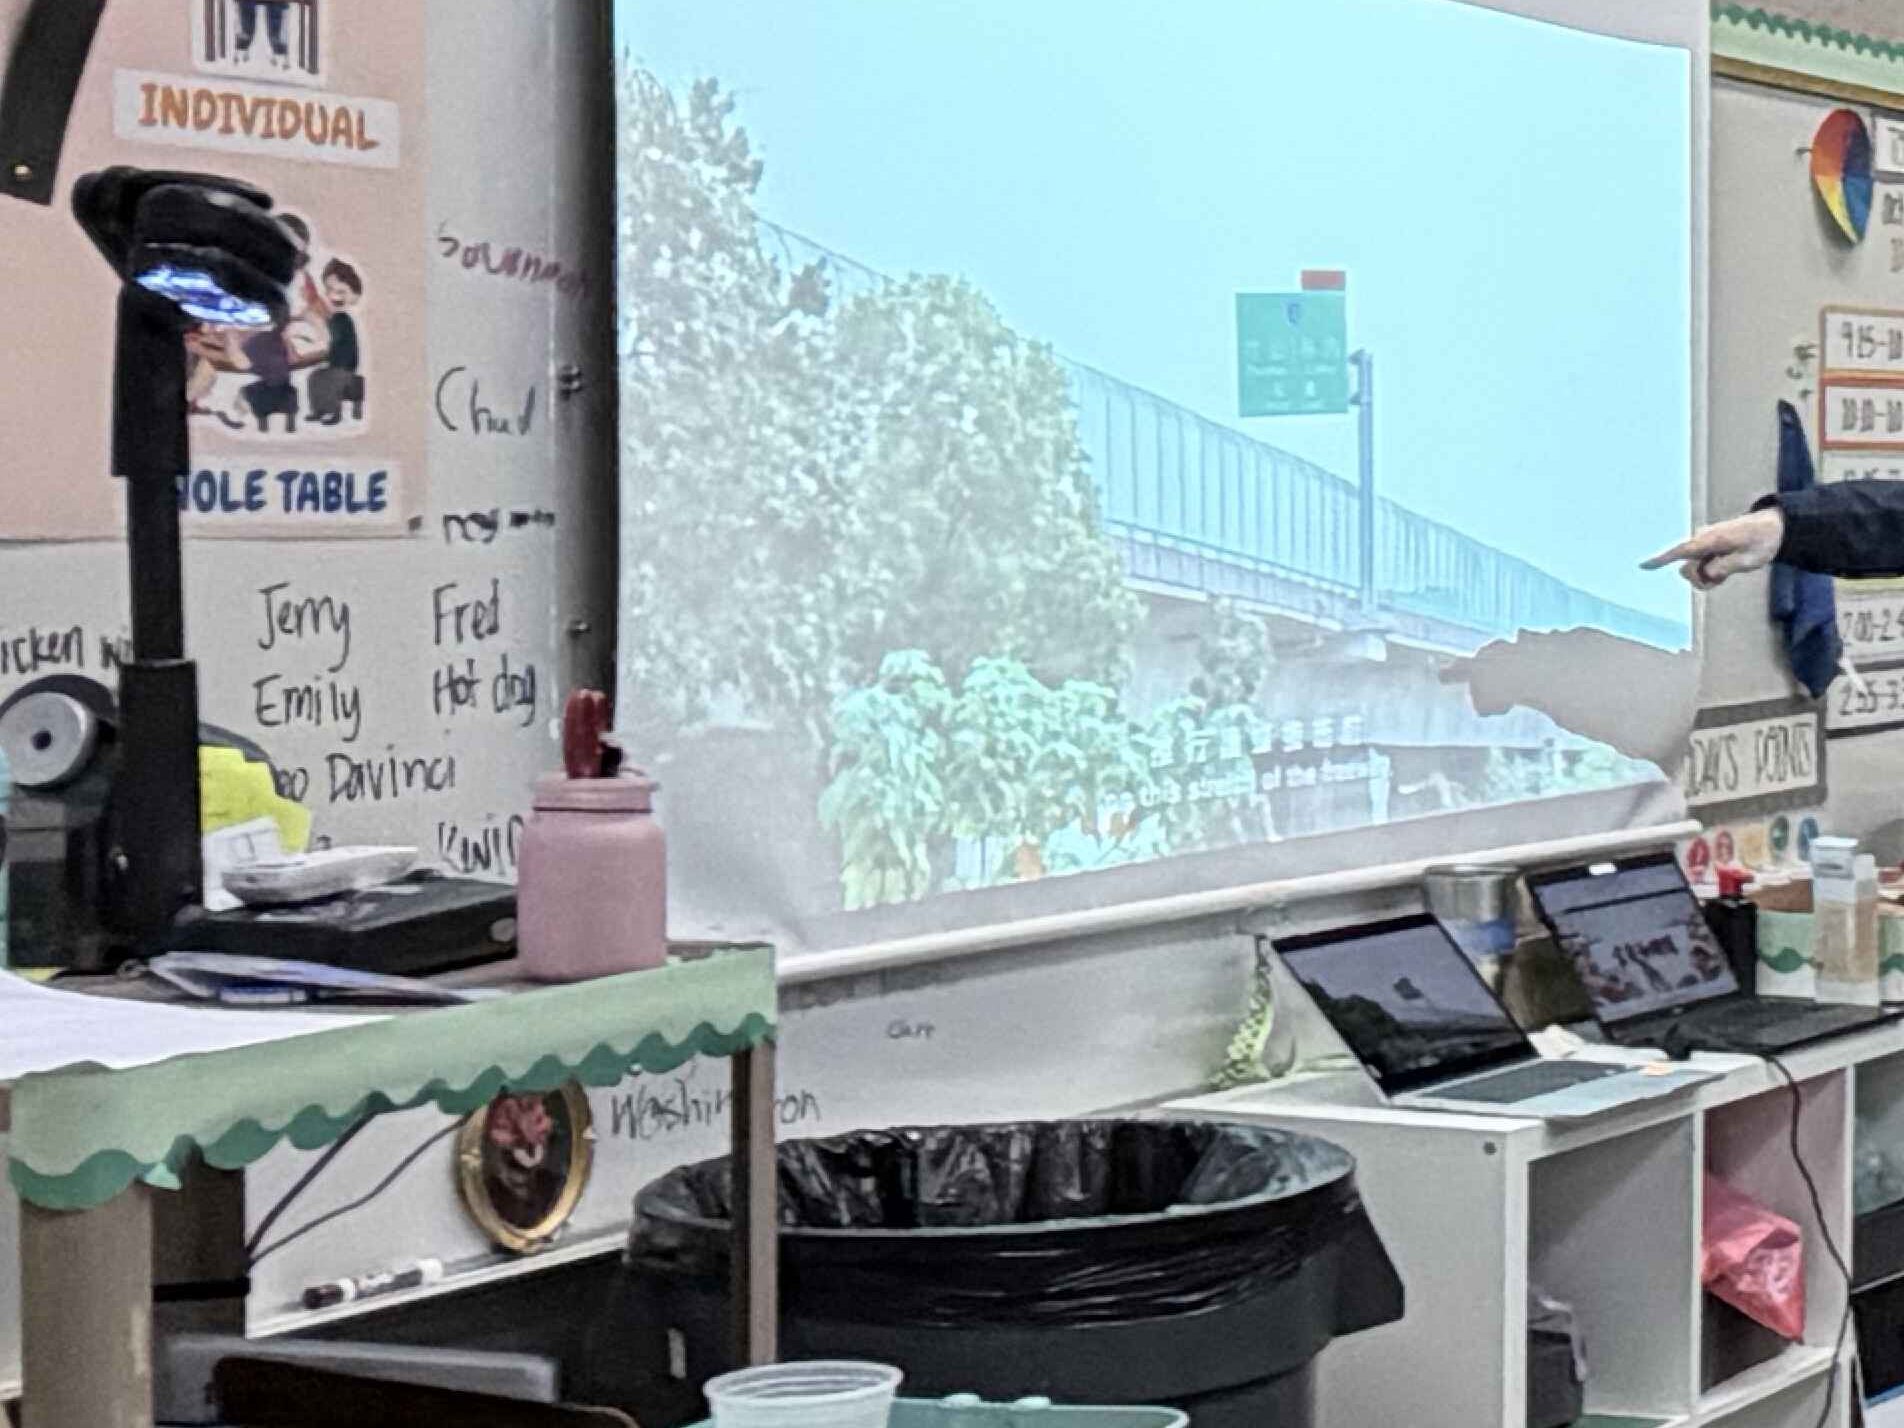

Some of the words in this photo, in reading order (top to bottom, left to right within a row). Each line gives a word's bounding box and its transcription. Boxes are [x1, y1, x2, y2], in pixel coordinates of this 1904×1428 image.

[138, 82, 380, 151] INDIVIDUAL
[276, 470, 388, 514] TABLE
[257, 582, 351, 672] Jerry
[431, 579, 500, 647] Fred
[253, 674, 360, 742] Emily
[276, 766, 308, 803] eo
